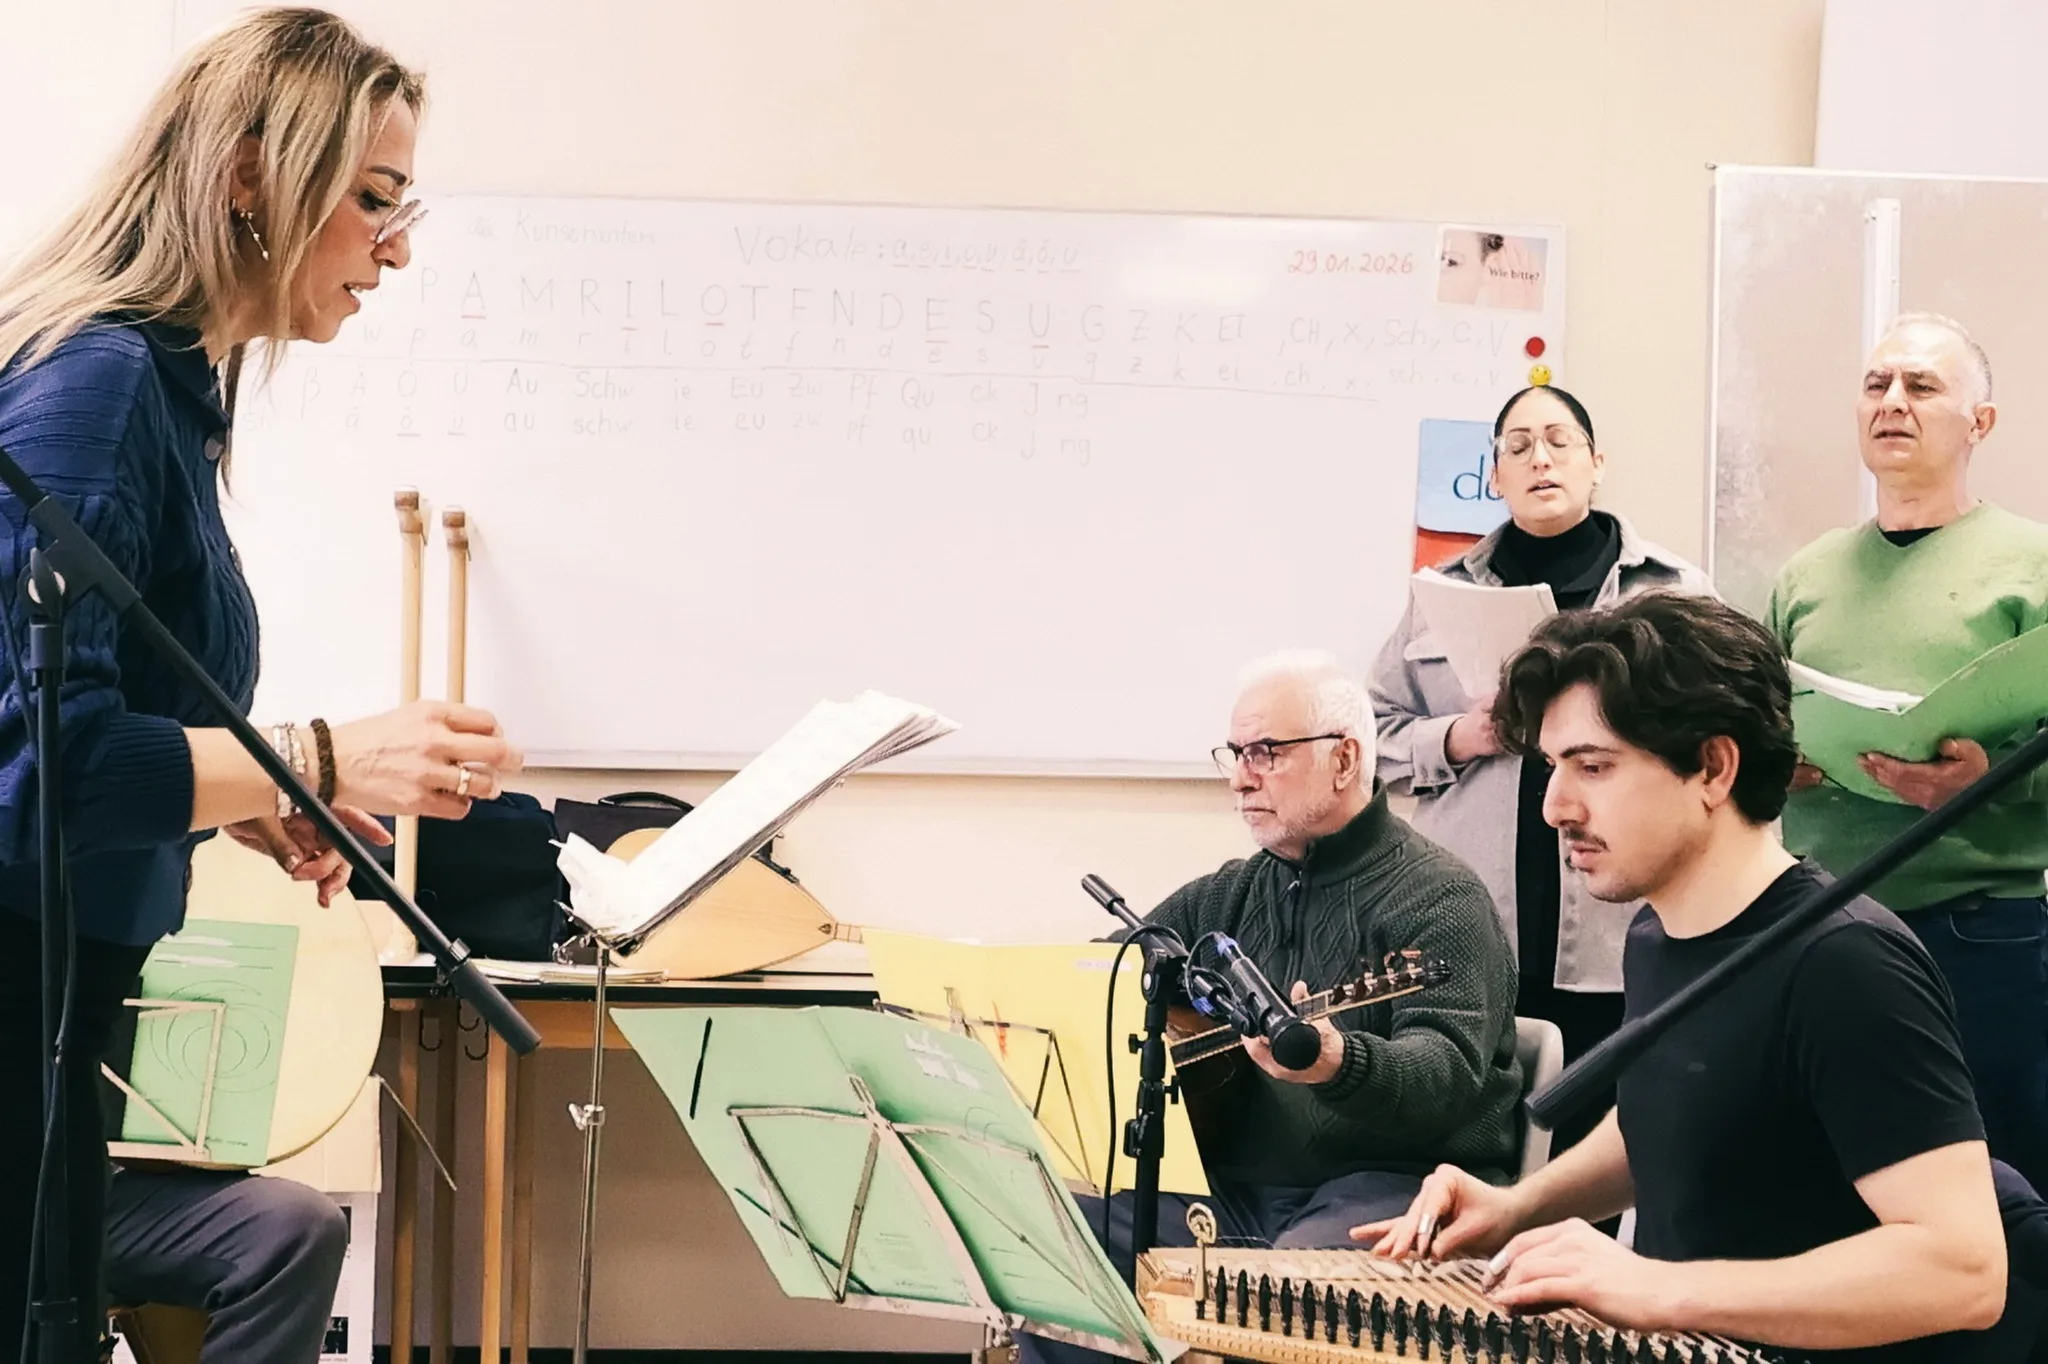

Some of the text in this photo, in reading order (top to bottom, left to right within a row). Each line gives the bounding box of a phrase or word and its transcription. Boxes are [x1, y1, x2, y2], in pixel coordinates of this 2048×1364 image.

[734, 224, 884, 265] Vokale:
[1286, 250, 1414, 275] 29.01.2026
[1488, 265, 1540, 285] Wie bitte?
